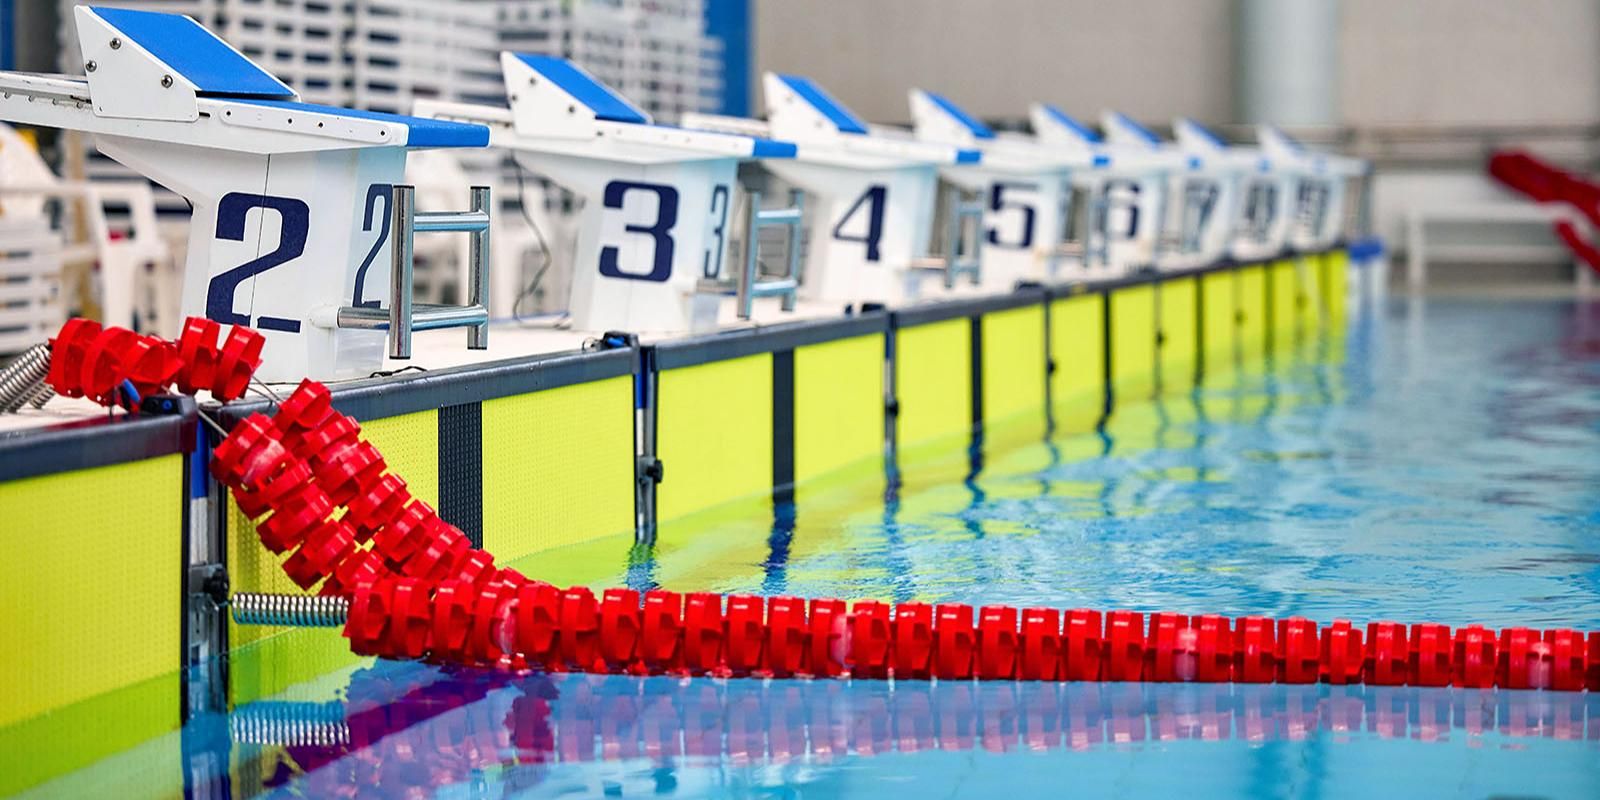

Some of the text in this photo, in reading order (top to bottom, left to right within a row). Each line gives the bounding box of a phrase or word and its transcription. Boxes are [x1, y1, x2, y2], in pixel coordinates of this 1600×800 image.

[206, 191, 309, 333] 2
[352, 183, 393, 309] 2
[599, 180, 679, 283] 3
[704, 184, 729, 279] 3
[833, 184, 887, 262] 4
[986, 183, 1038, 249] 5
